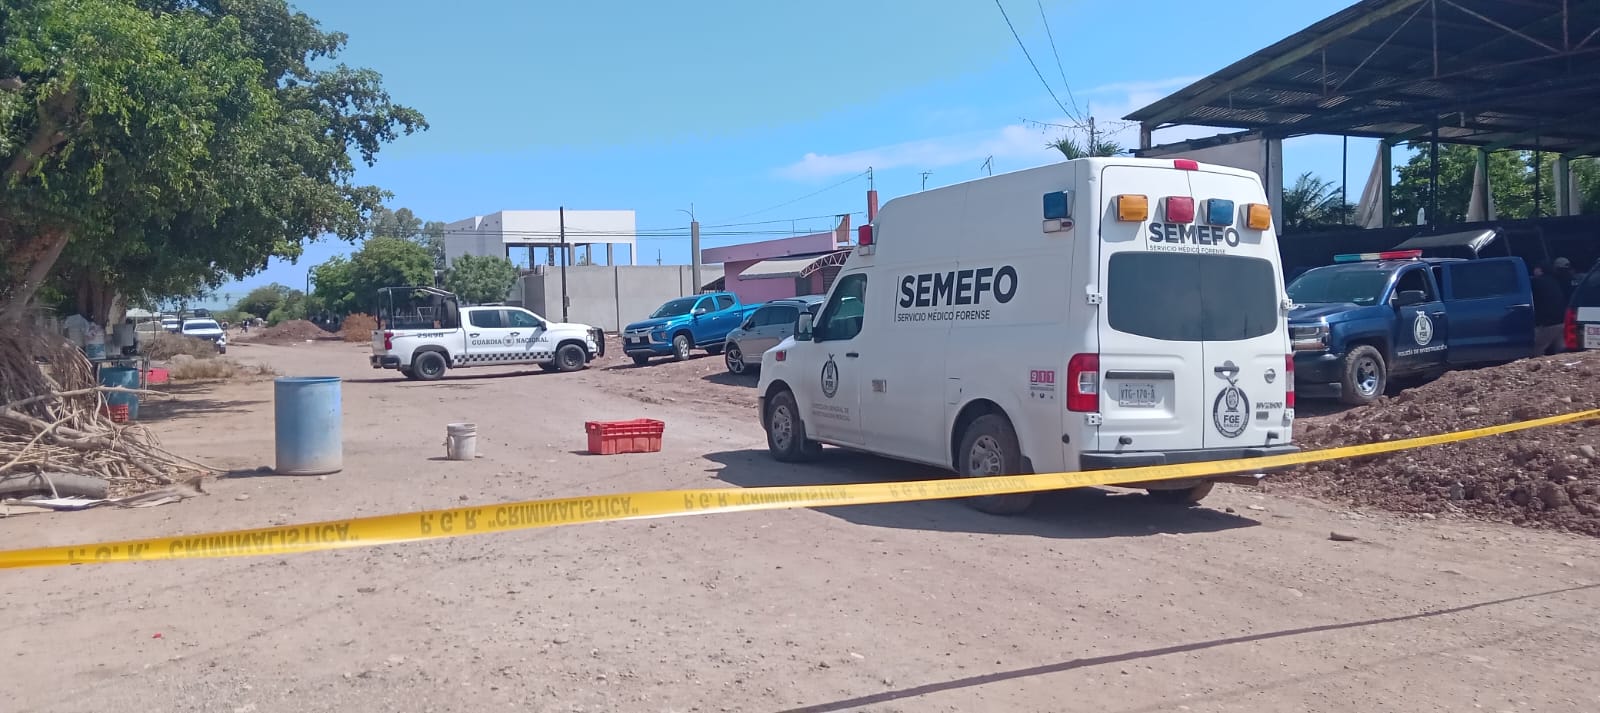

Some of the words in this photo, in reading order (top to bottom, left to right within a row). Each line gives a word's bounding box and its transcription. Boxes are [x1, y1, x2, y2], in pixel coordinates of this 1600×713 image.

[1149, 222, 1240, 247] SEMEFO
[899, 265, 1018, 308] SEMEFO
[897, 312, 926, 322] SERVICIO
[927, 309, 954, 321] MÉDICO
[955, 309, 991, 321] FORENSE
[515, 336, 549, 344] NACIONAL
[1030, 370, 1055, 383] 911
[1223, 414, 1240, 423] FGE
